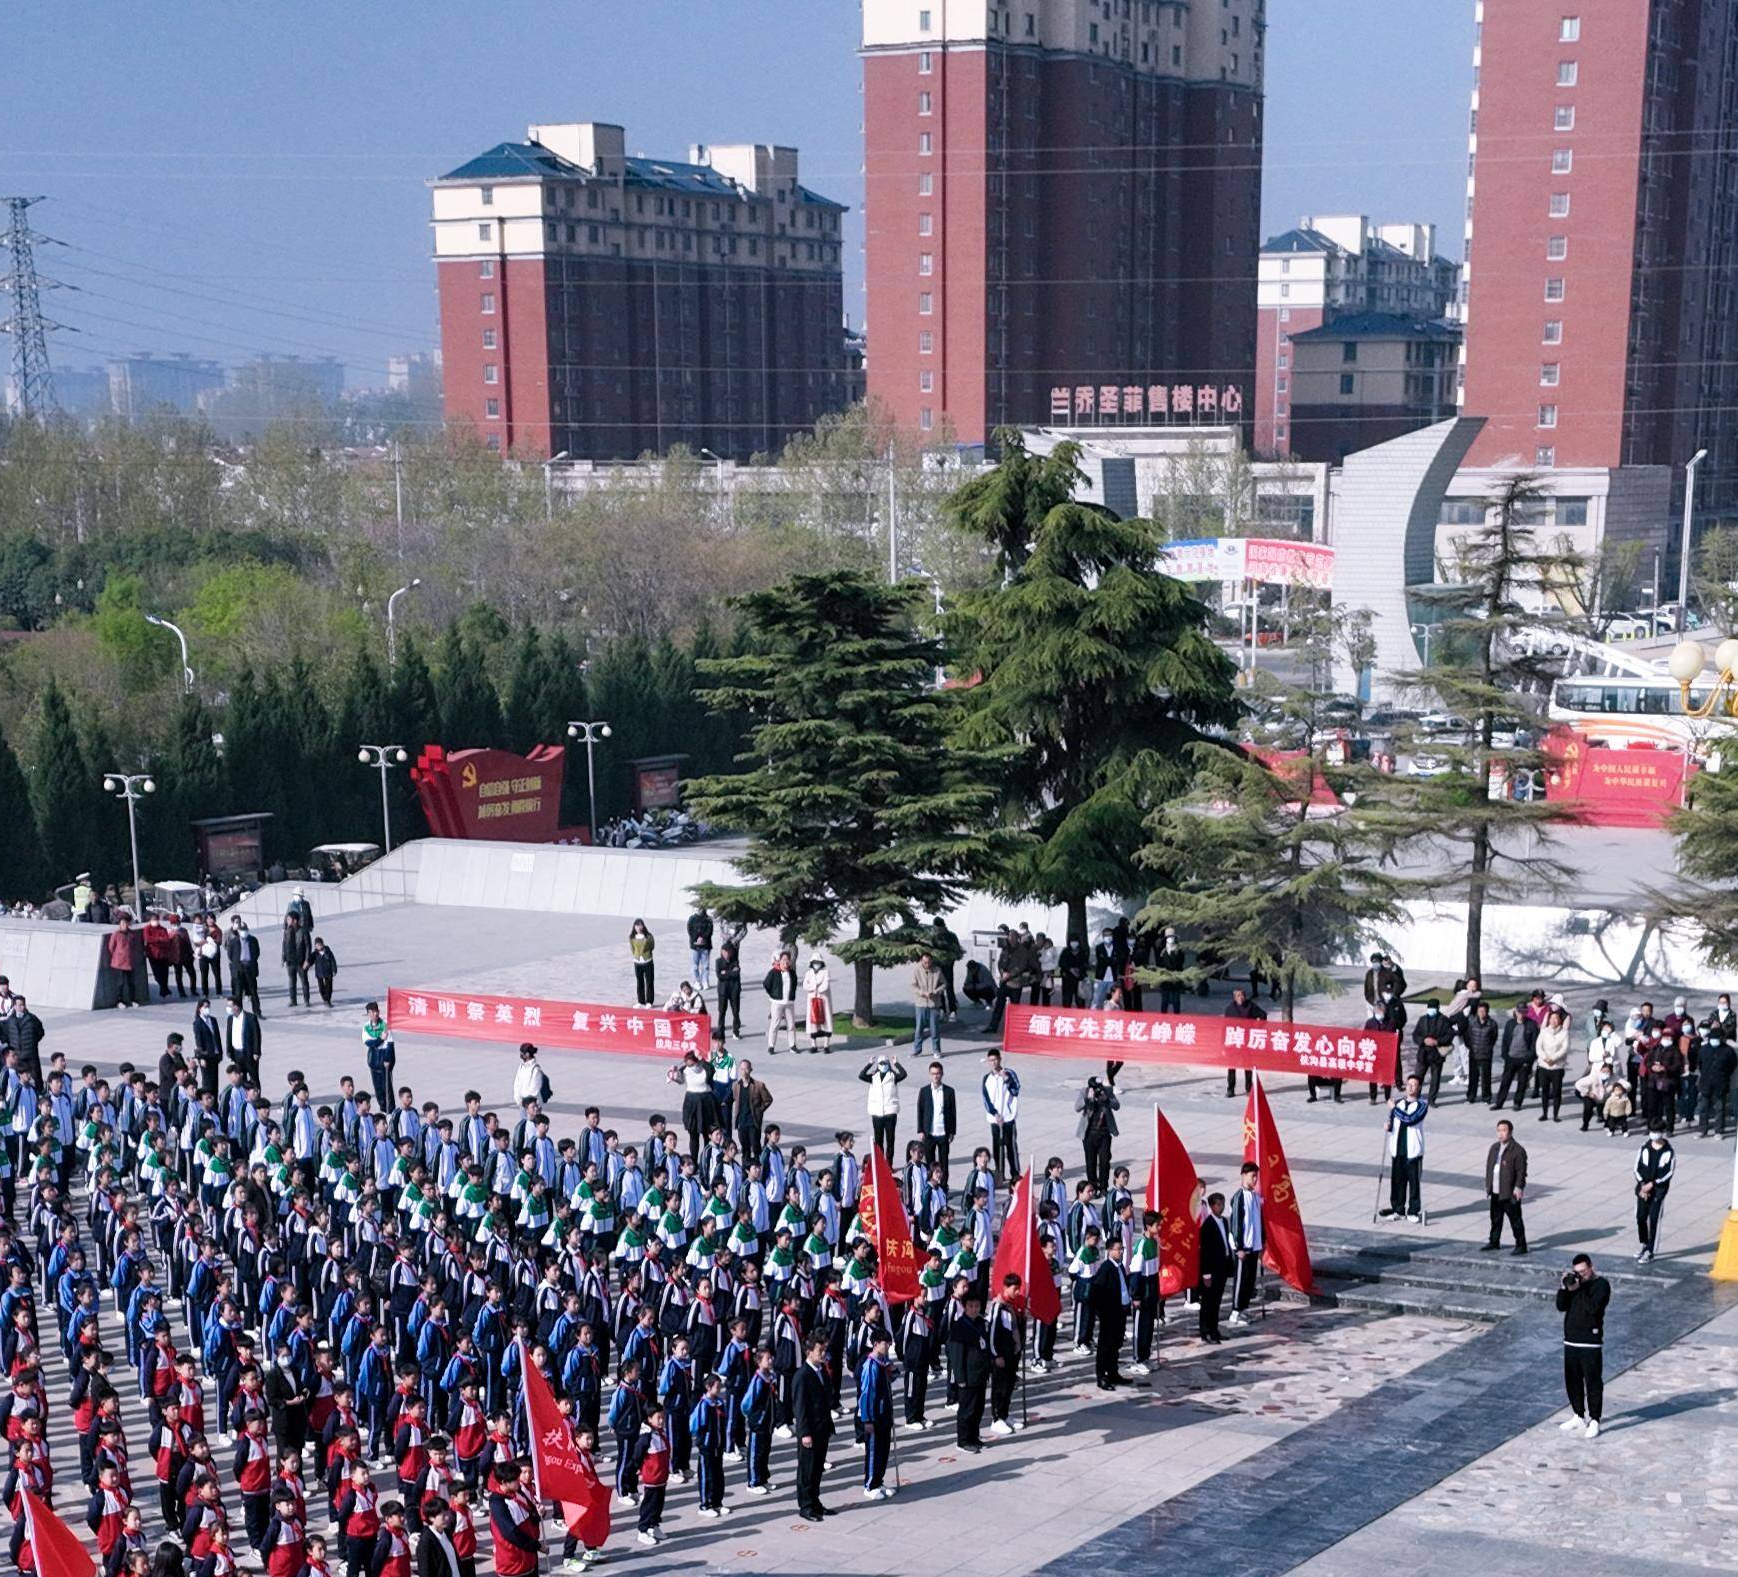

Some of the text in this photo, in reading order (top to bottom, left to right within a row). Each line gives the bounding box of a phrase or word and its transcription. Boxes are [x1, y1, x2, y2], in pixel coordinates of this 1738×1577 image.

[1051, 384, 1243, 413] 兰乔圣菲售楼中心
[408, 996, 700, 1041] 清明祭英烈 复兴中国梦
[1027, 1013, 1378, 1061] 缅怀先烈忆峥嵘 踔厉奋发心向党
